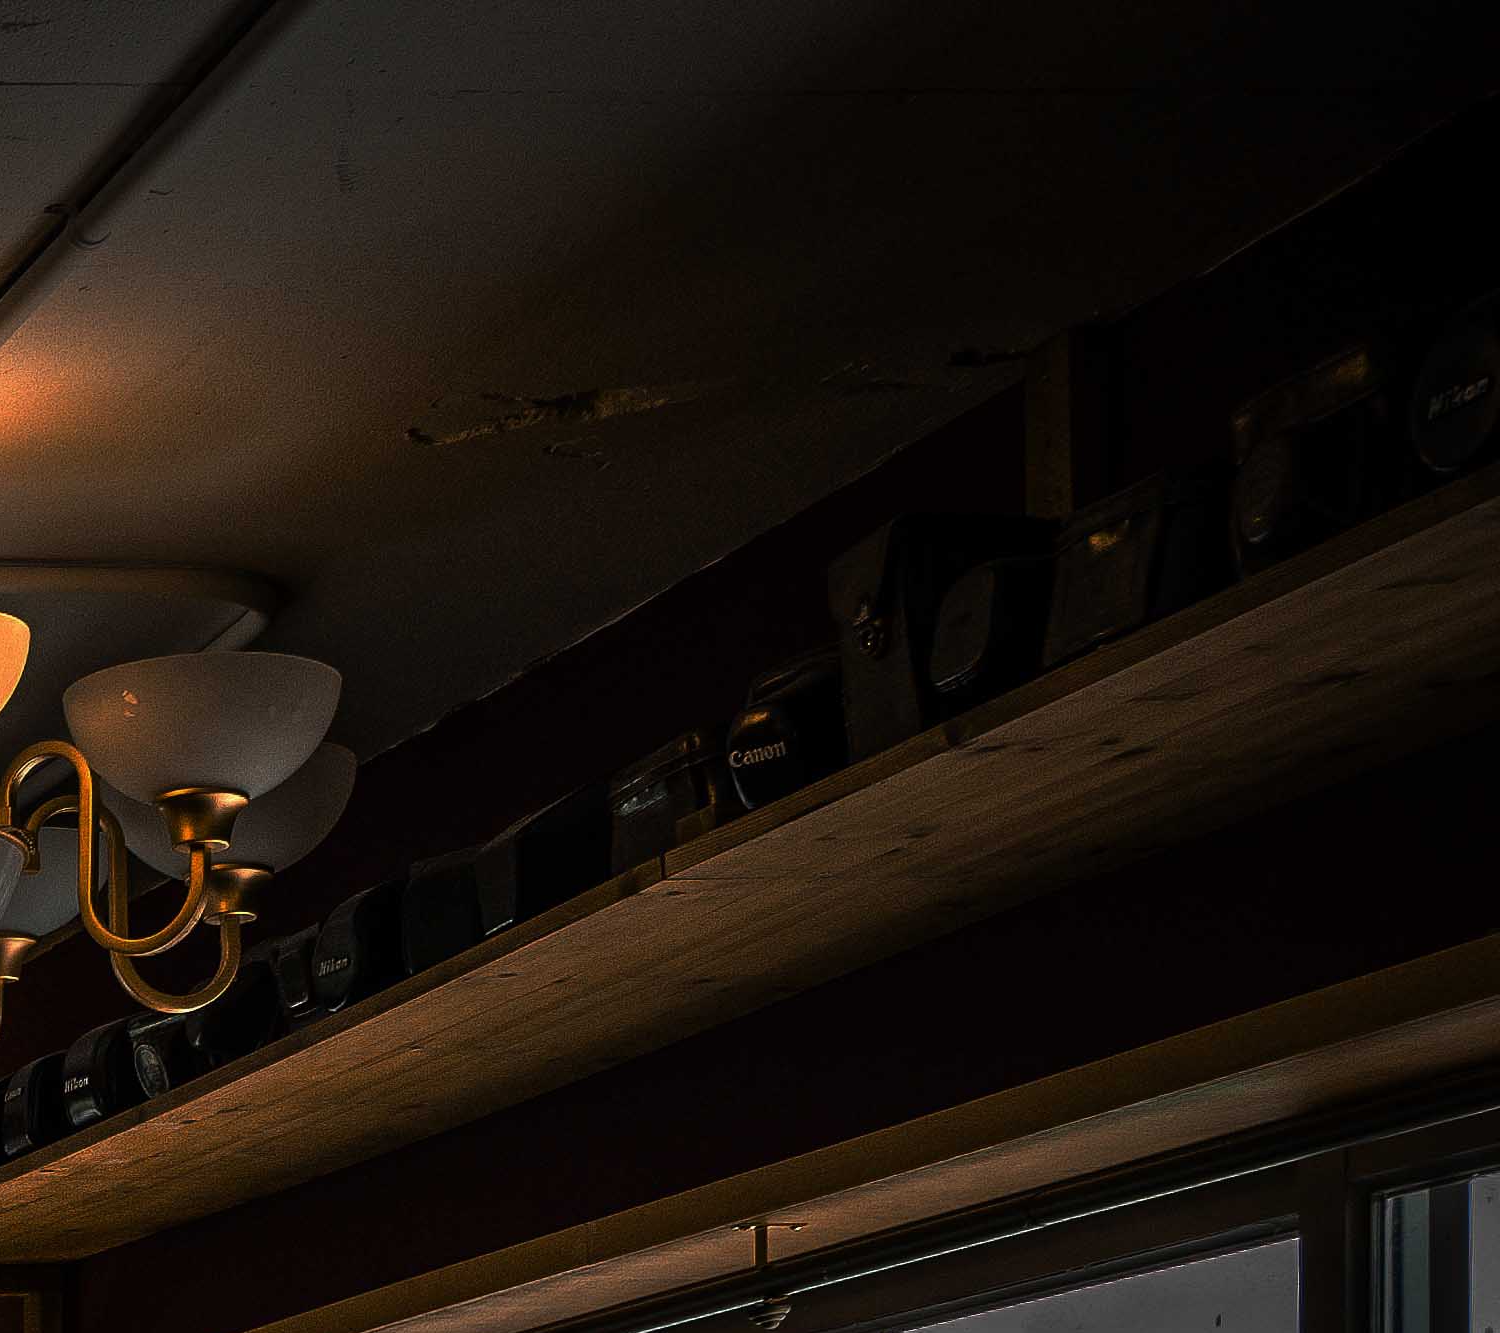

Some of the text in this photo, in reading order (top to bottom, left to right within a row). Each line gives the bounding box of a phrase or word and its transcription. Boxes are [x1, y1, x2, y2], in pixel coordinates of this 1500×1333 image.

[728, 738, 788, 769] Canon
[317, 952, 351, 977] Nikon
[64, 1075, 90, 1094] Nikon
